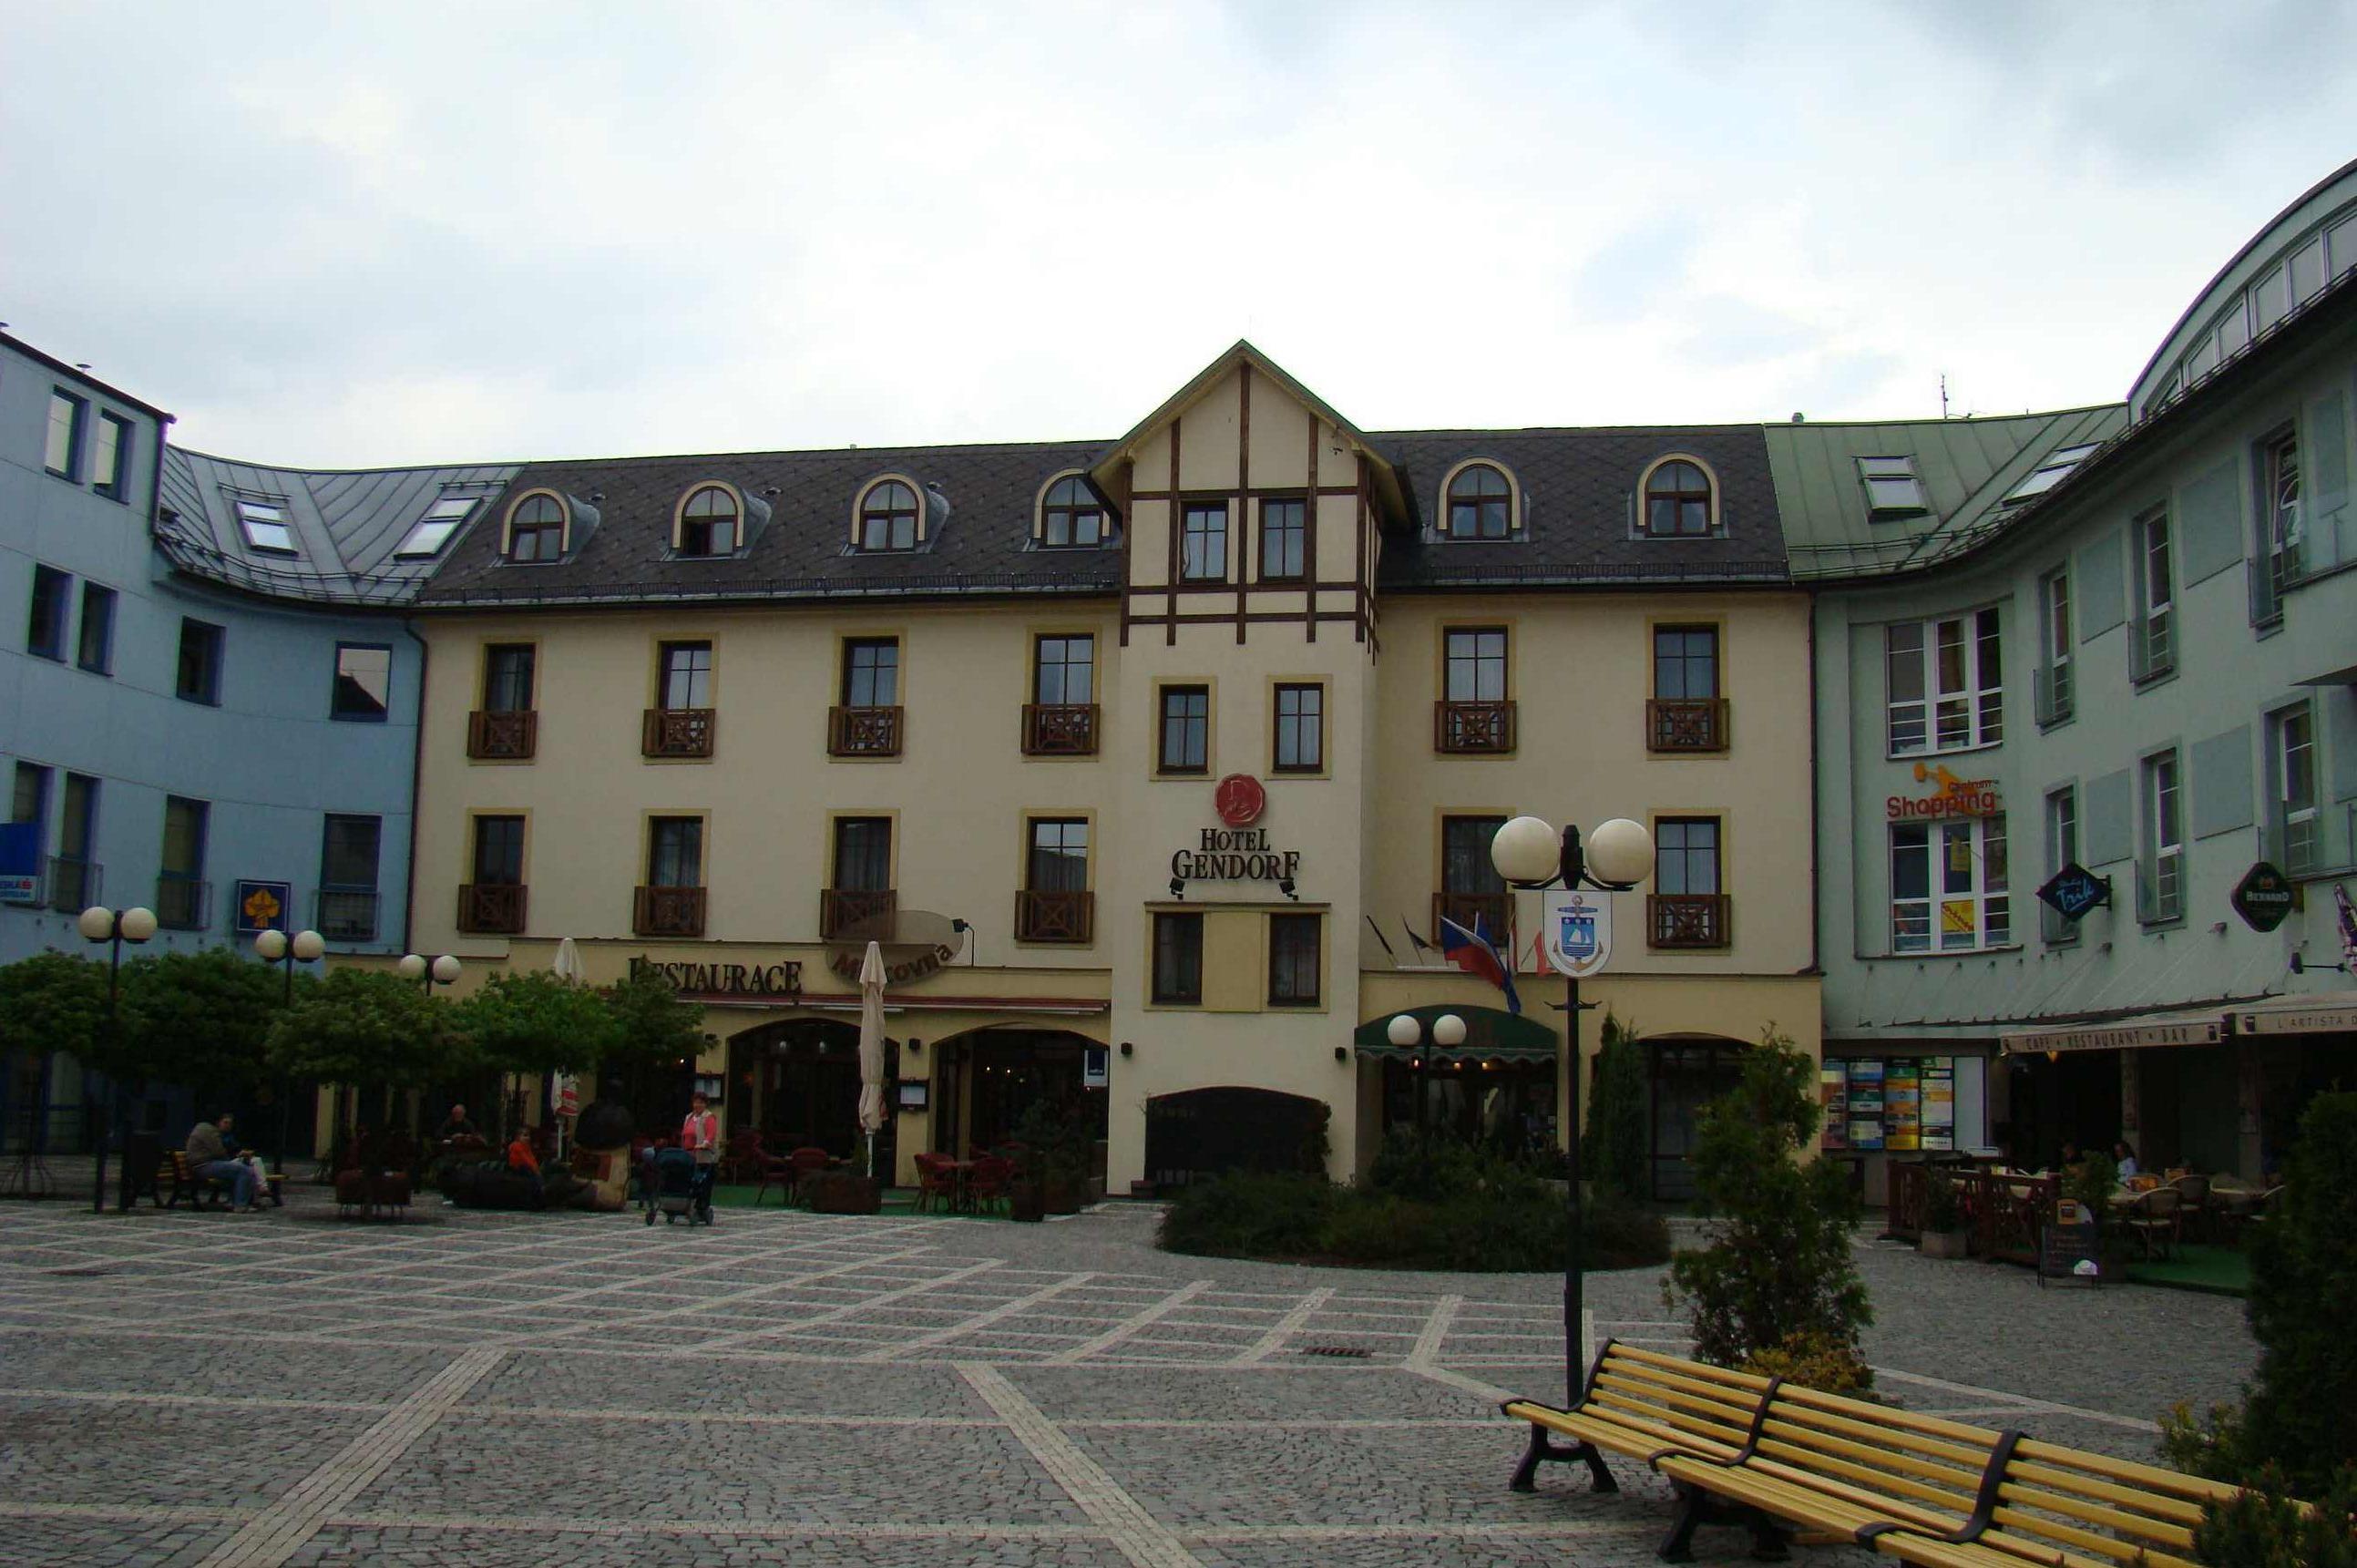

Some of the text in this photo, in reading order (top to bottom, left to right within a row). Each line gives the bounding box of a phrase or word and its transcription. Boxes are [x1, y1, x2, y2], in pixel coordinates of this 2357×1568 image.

[1887, 791, 1996, 818] Shopping
[1200, 828, 1270, 851] HOTEL
[1172, 849, 1300, 880] GENDORF
[2066, 1030, 2140, 1049] RESTAURANT
[2161, 1027, 2188, 1043] BAR
